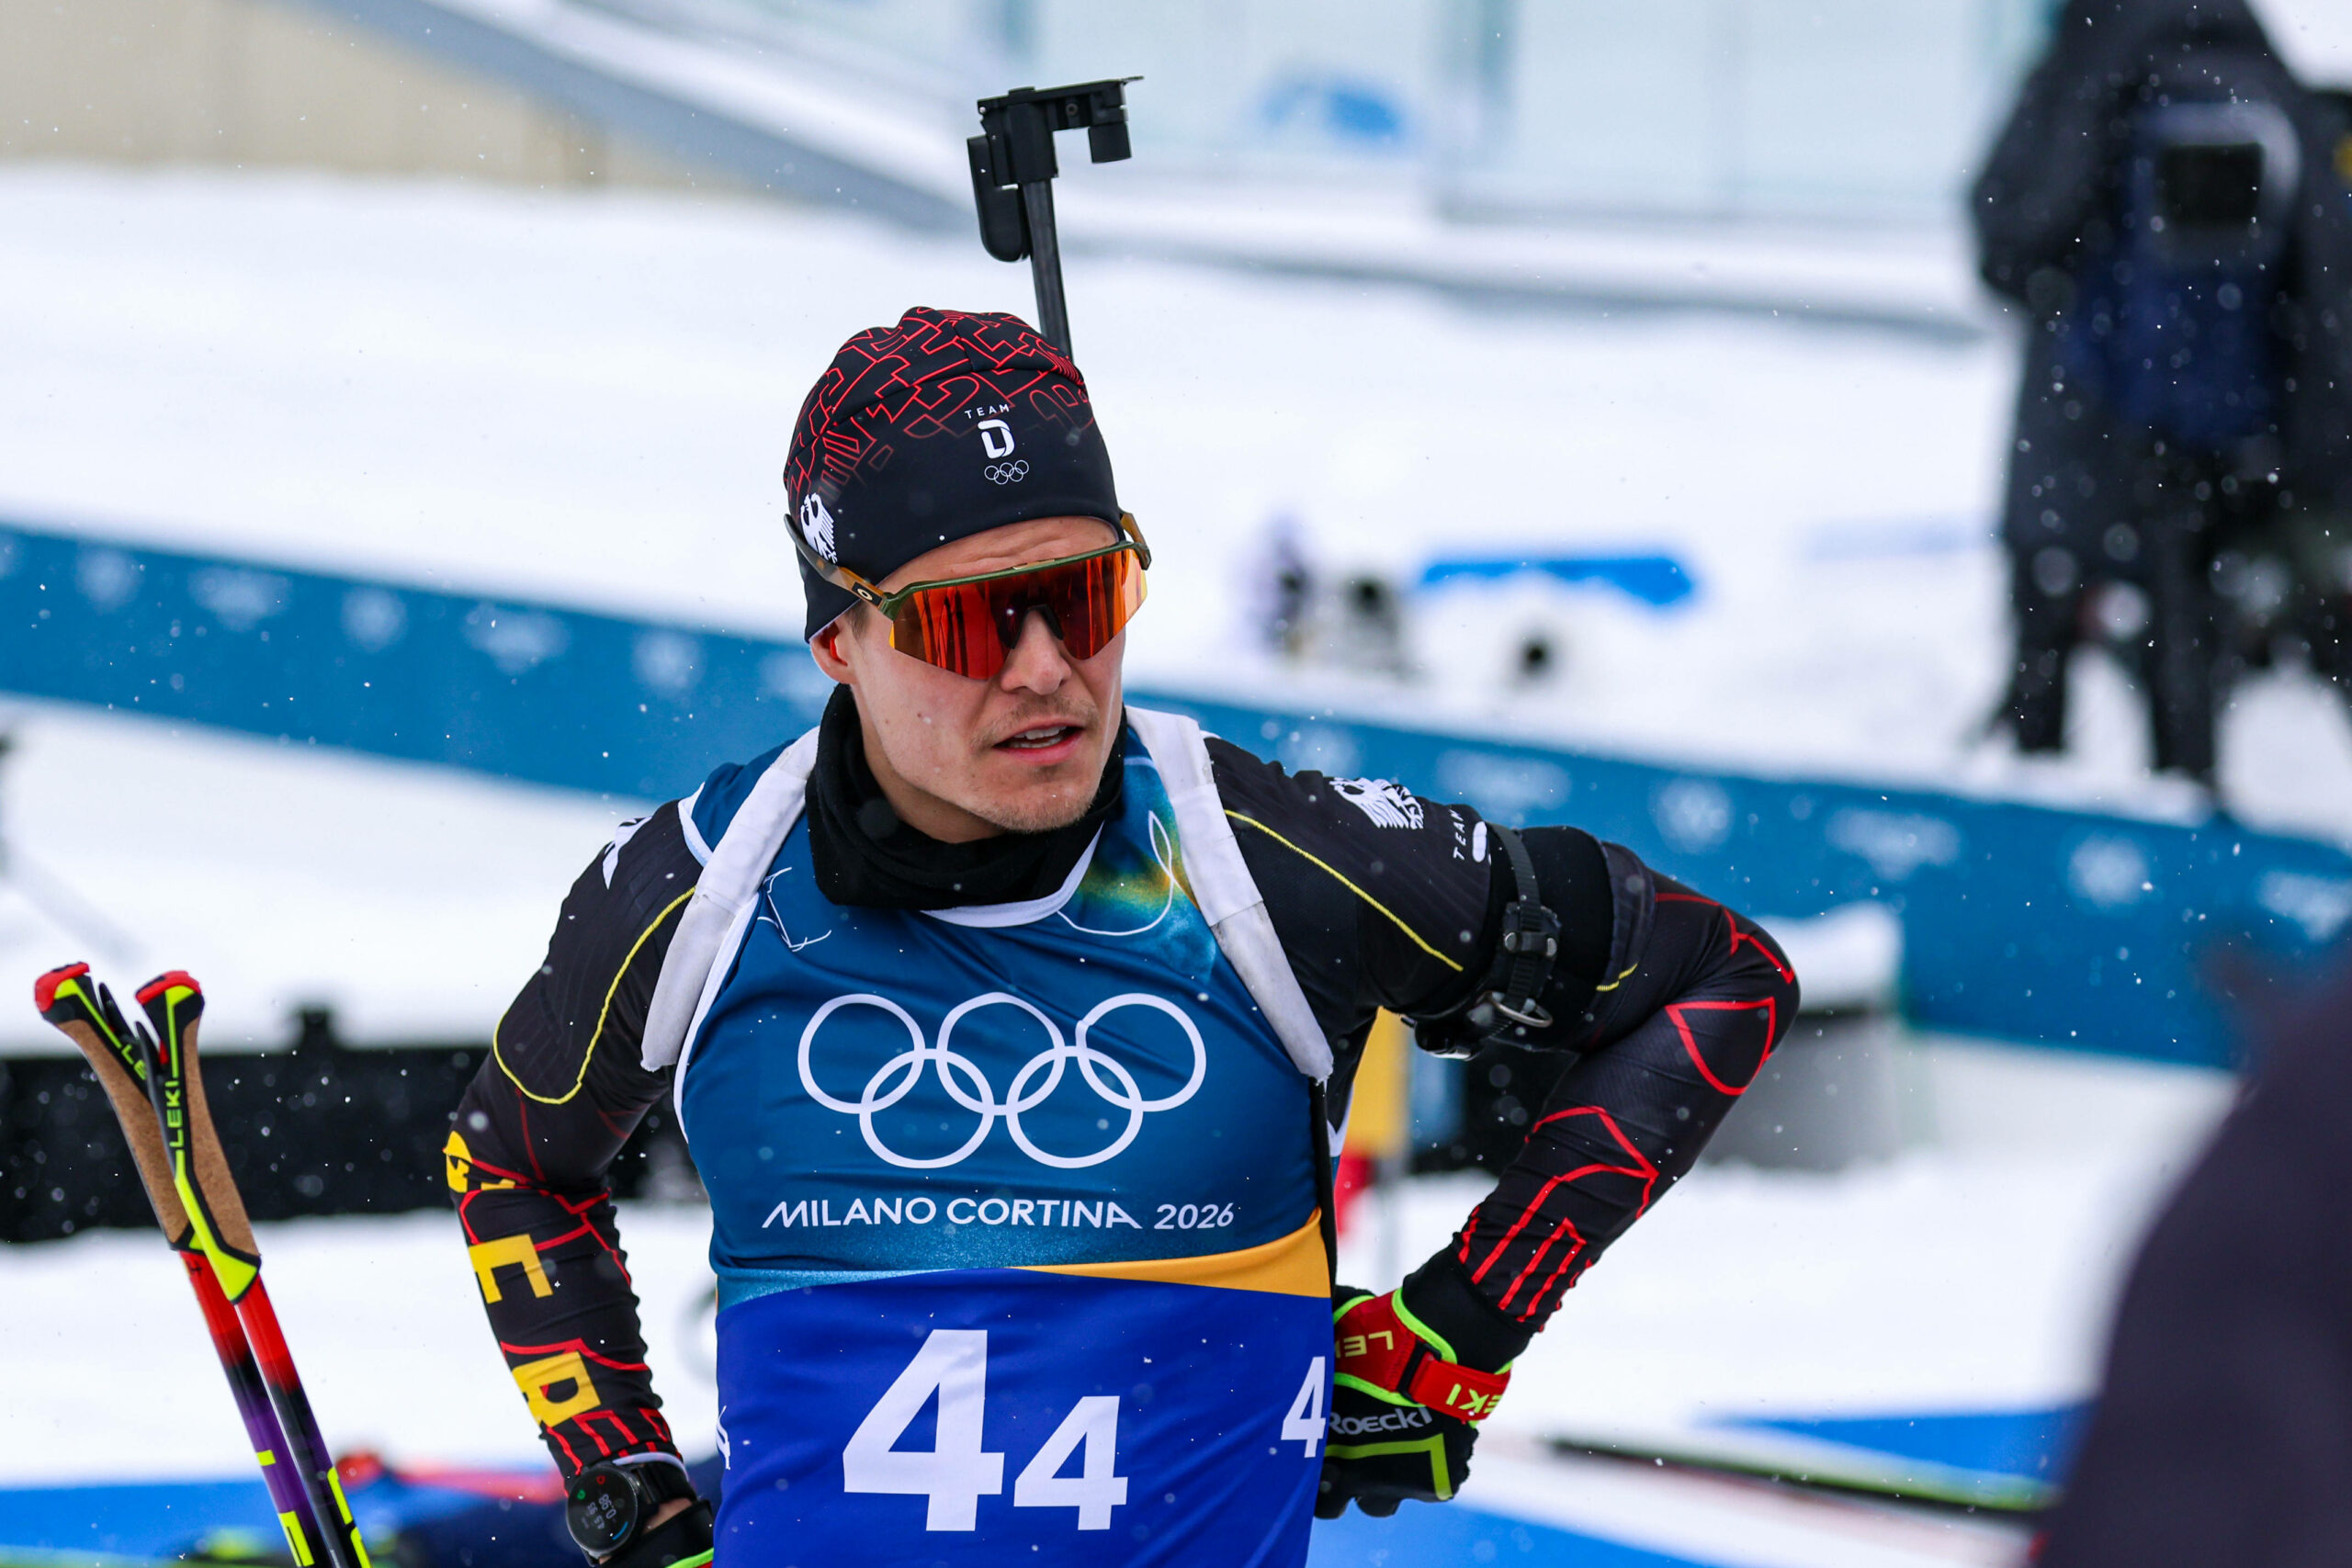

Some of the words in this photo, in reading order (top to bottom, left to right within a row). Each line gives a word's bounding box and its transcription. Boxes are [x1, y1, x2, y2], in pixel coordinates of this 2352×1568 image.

[964, 404, 1010, 419] TEAM
[165, 1080, 184, 1147] LEKI
[762, 1197, 937, 1229] MILANO
[946, 1197, 1143, 1230] CORTINA
[1154, 1201, 1235, 1230] 2026
[842, 1328, 1005, 1532] 4
[1013, 1395, 1128, 1530] 4
[1281, 1356, 1327, 1459] 4
